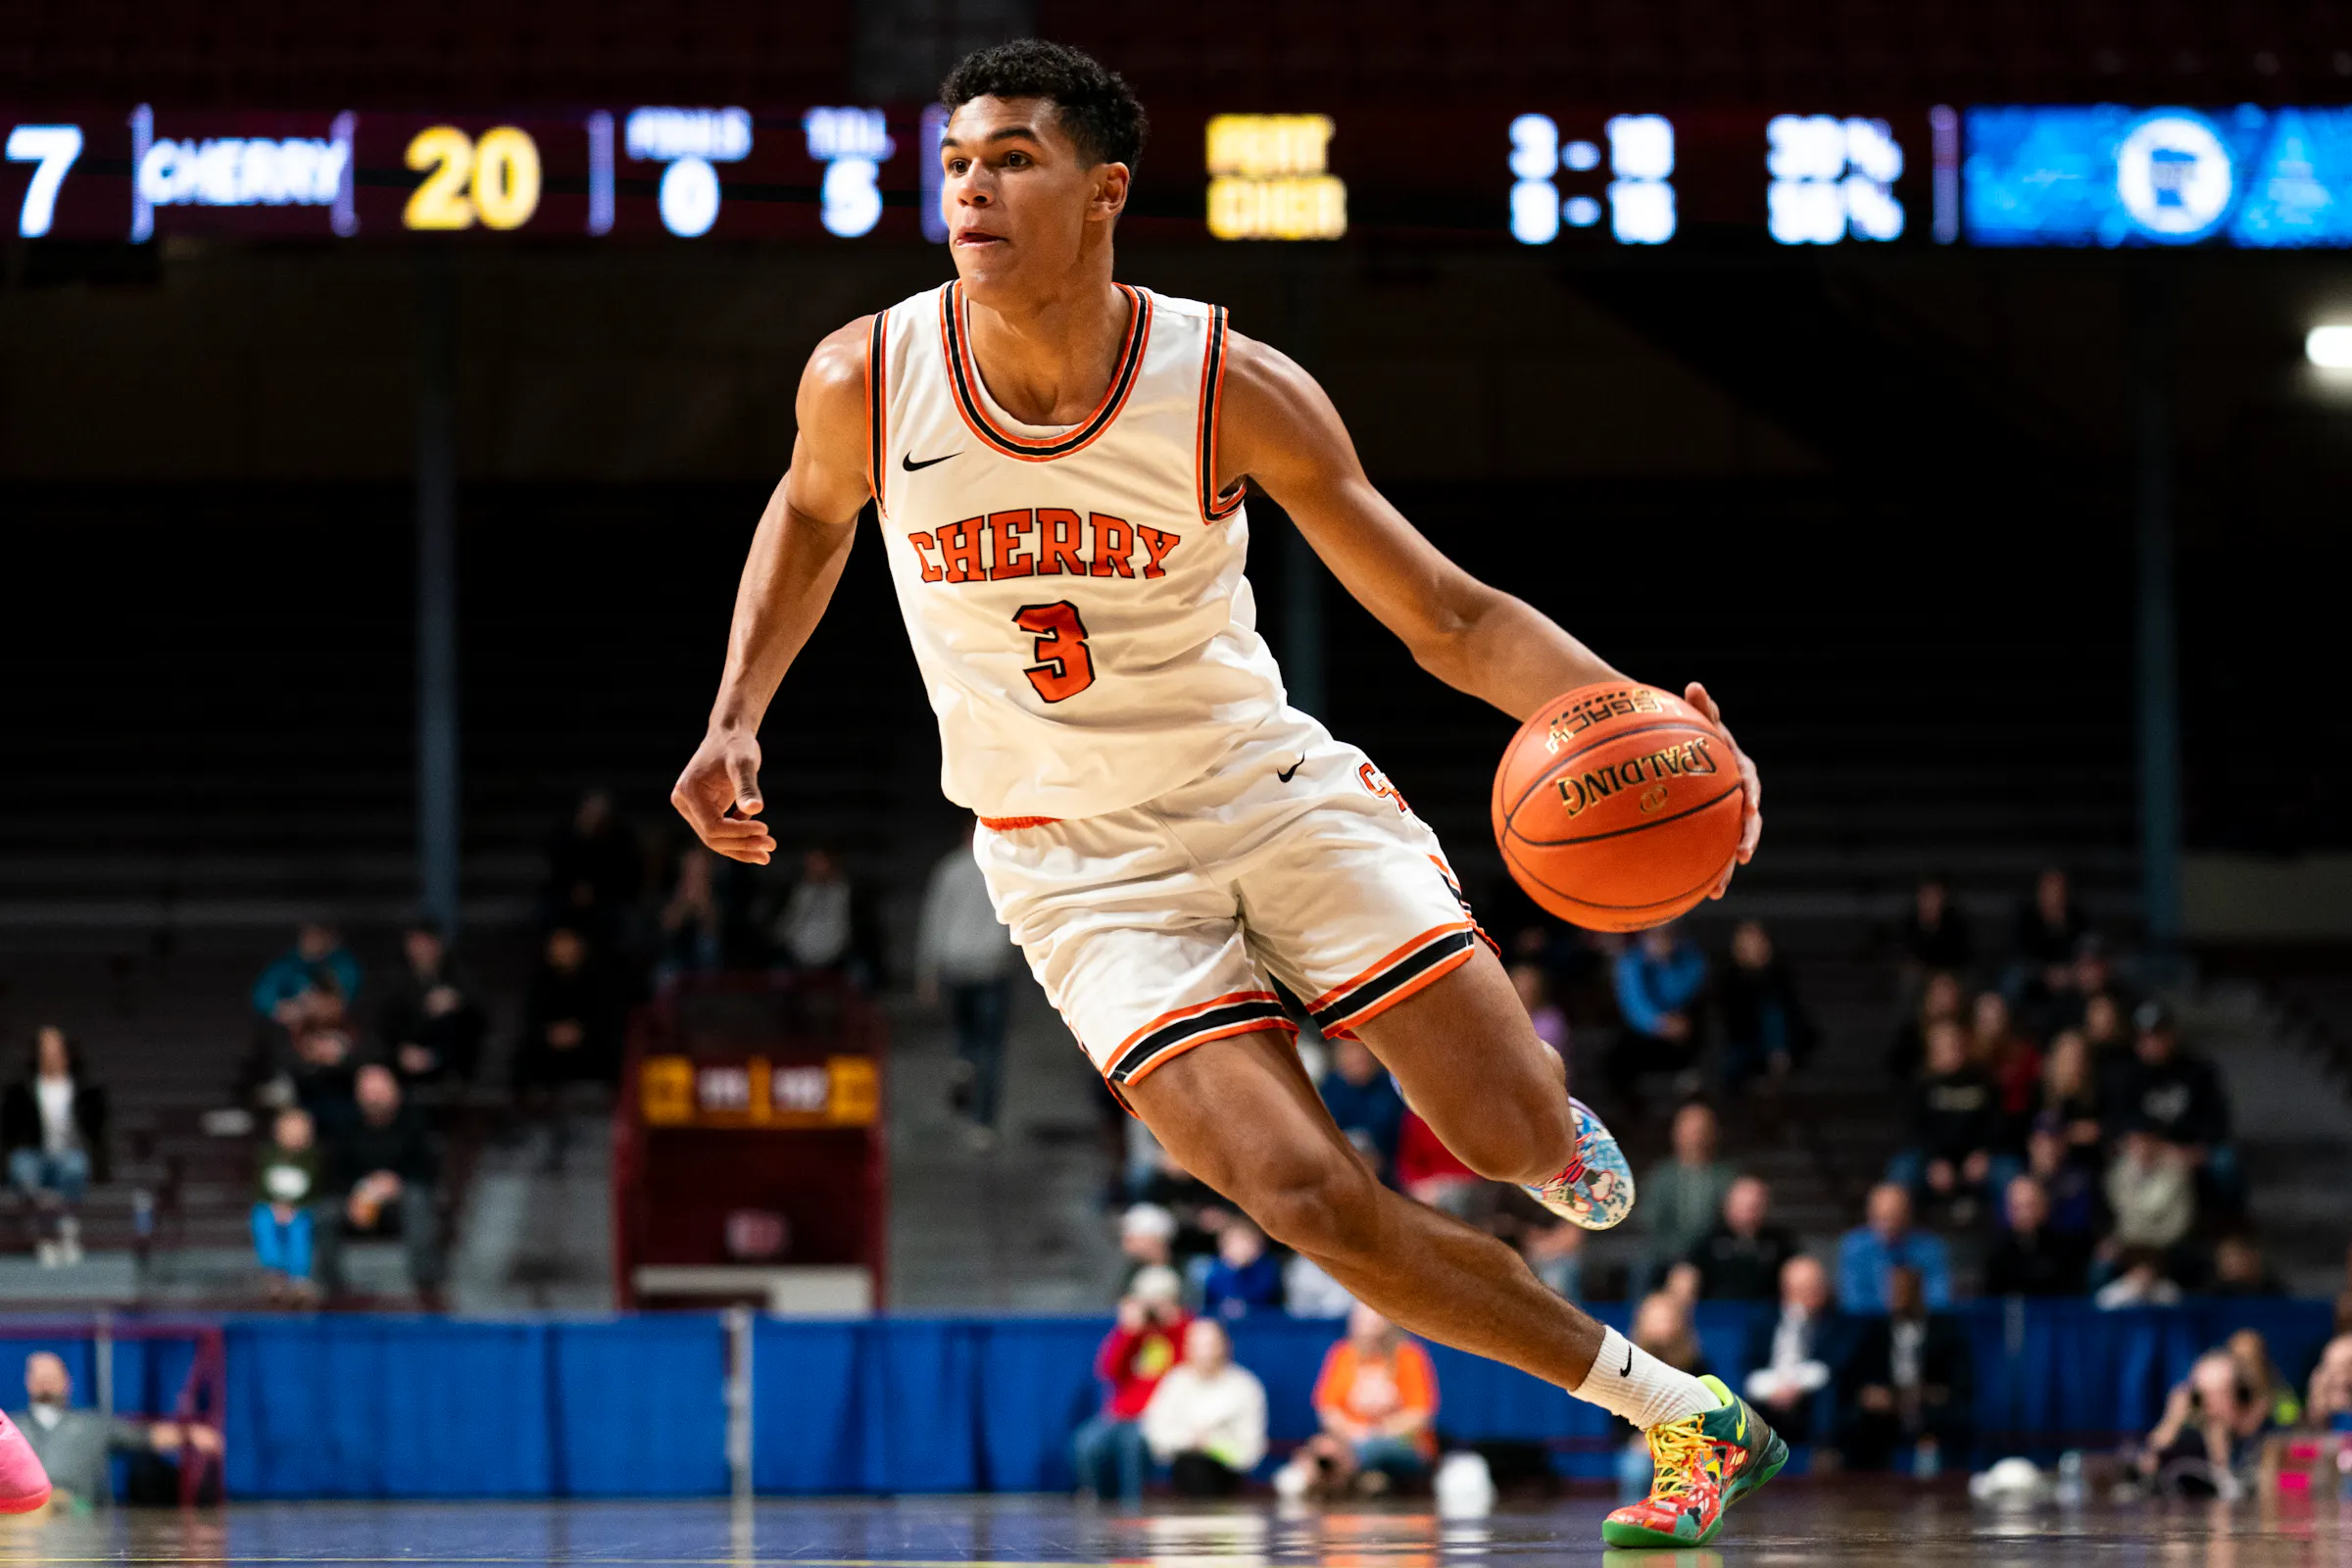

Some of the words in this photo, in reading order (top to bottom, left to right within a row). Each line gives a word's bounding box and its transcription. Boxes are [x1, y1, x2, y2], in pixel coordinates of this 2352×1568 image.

[5, 123, 82, 238] 7
[142, 137, 346, 206] CHERRY
[403, 123, 541, 230] 20
[660, 157, 721, 237] 0
[820, 157, 883, 237] 5
[907, 508, 1181, 583] CHERRY
[1011, 600, 1096, 704] 3
[1556, 737, 1717, 819] SPALDING
